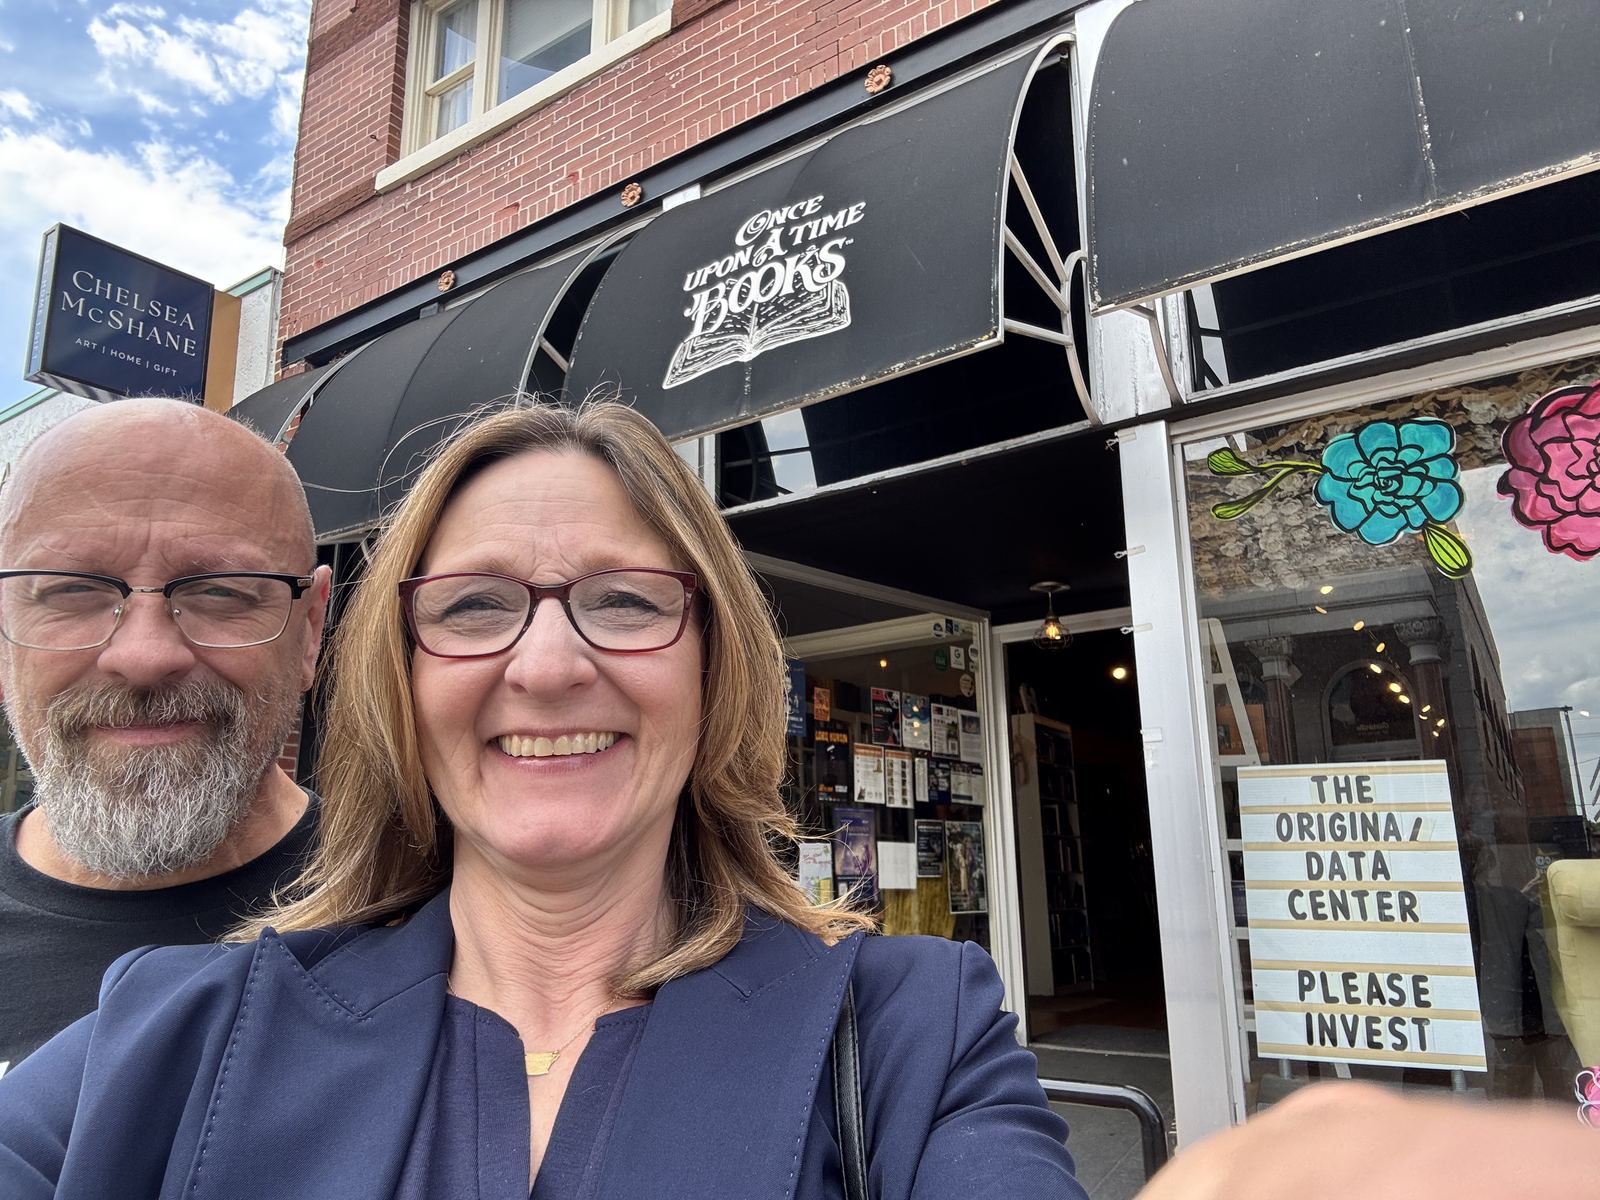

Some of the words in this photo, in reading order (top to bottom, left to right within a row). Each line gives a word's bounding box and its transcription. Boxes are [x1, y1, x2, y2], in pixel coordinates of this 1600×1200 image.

[734, 195, 825, 246] ONCE
[683, 244, 755, 291] UPON
[753, 227, 788, 267] A
[789, 202, 867, 246] TIME
[72, 270, 196, 331] CHELSEA
[684, 237, 847, 337] BOOKS
[75, 337, 98, 350] ART
[110, 349, 142, 365] HOME
[153, 363, 178, 377] GIFT
[1311, 775, 1374, 804] THE
[1305, 850, 1391, 881] DATA
[1287, 889, 1420, 923] CENTER
[1297, 969, 1432, 1008] PLEASE
[1306, 1012, 1431, 1052] INVEST
